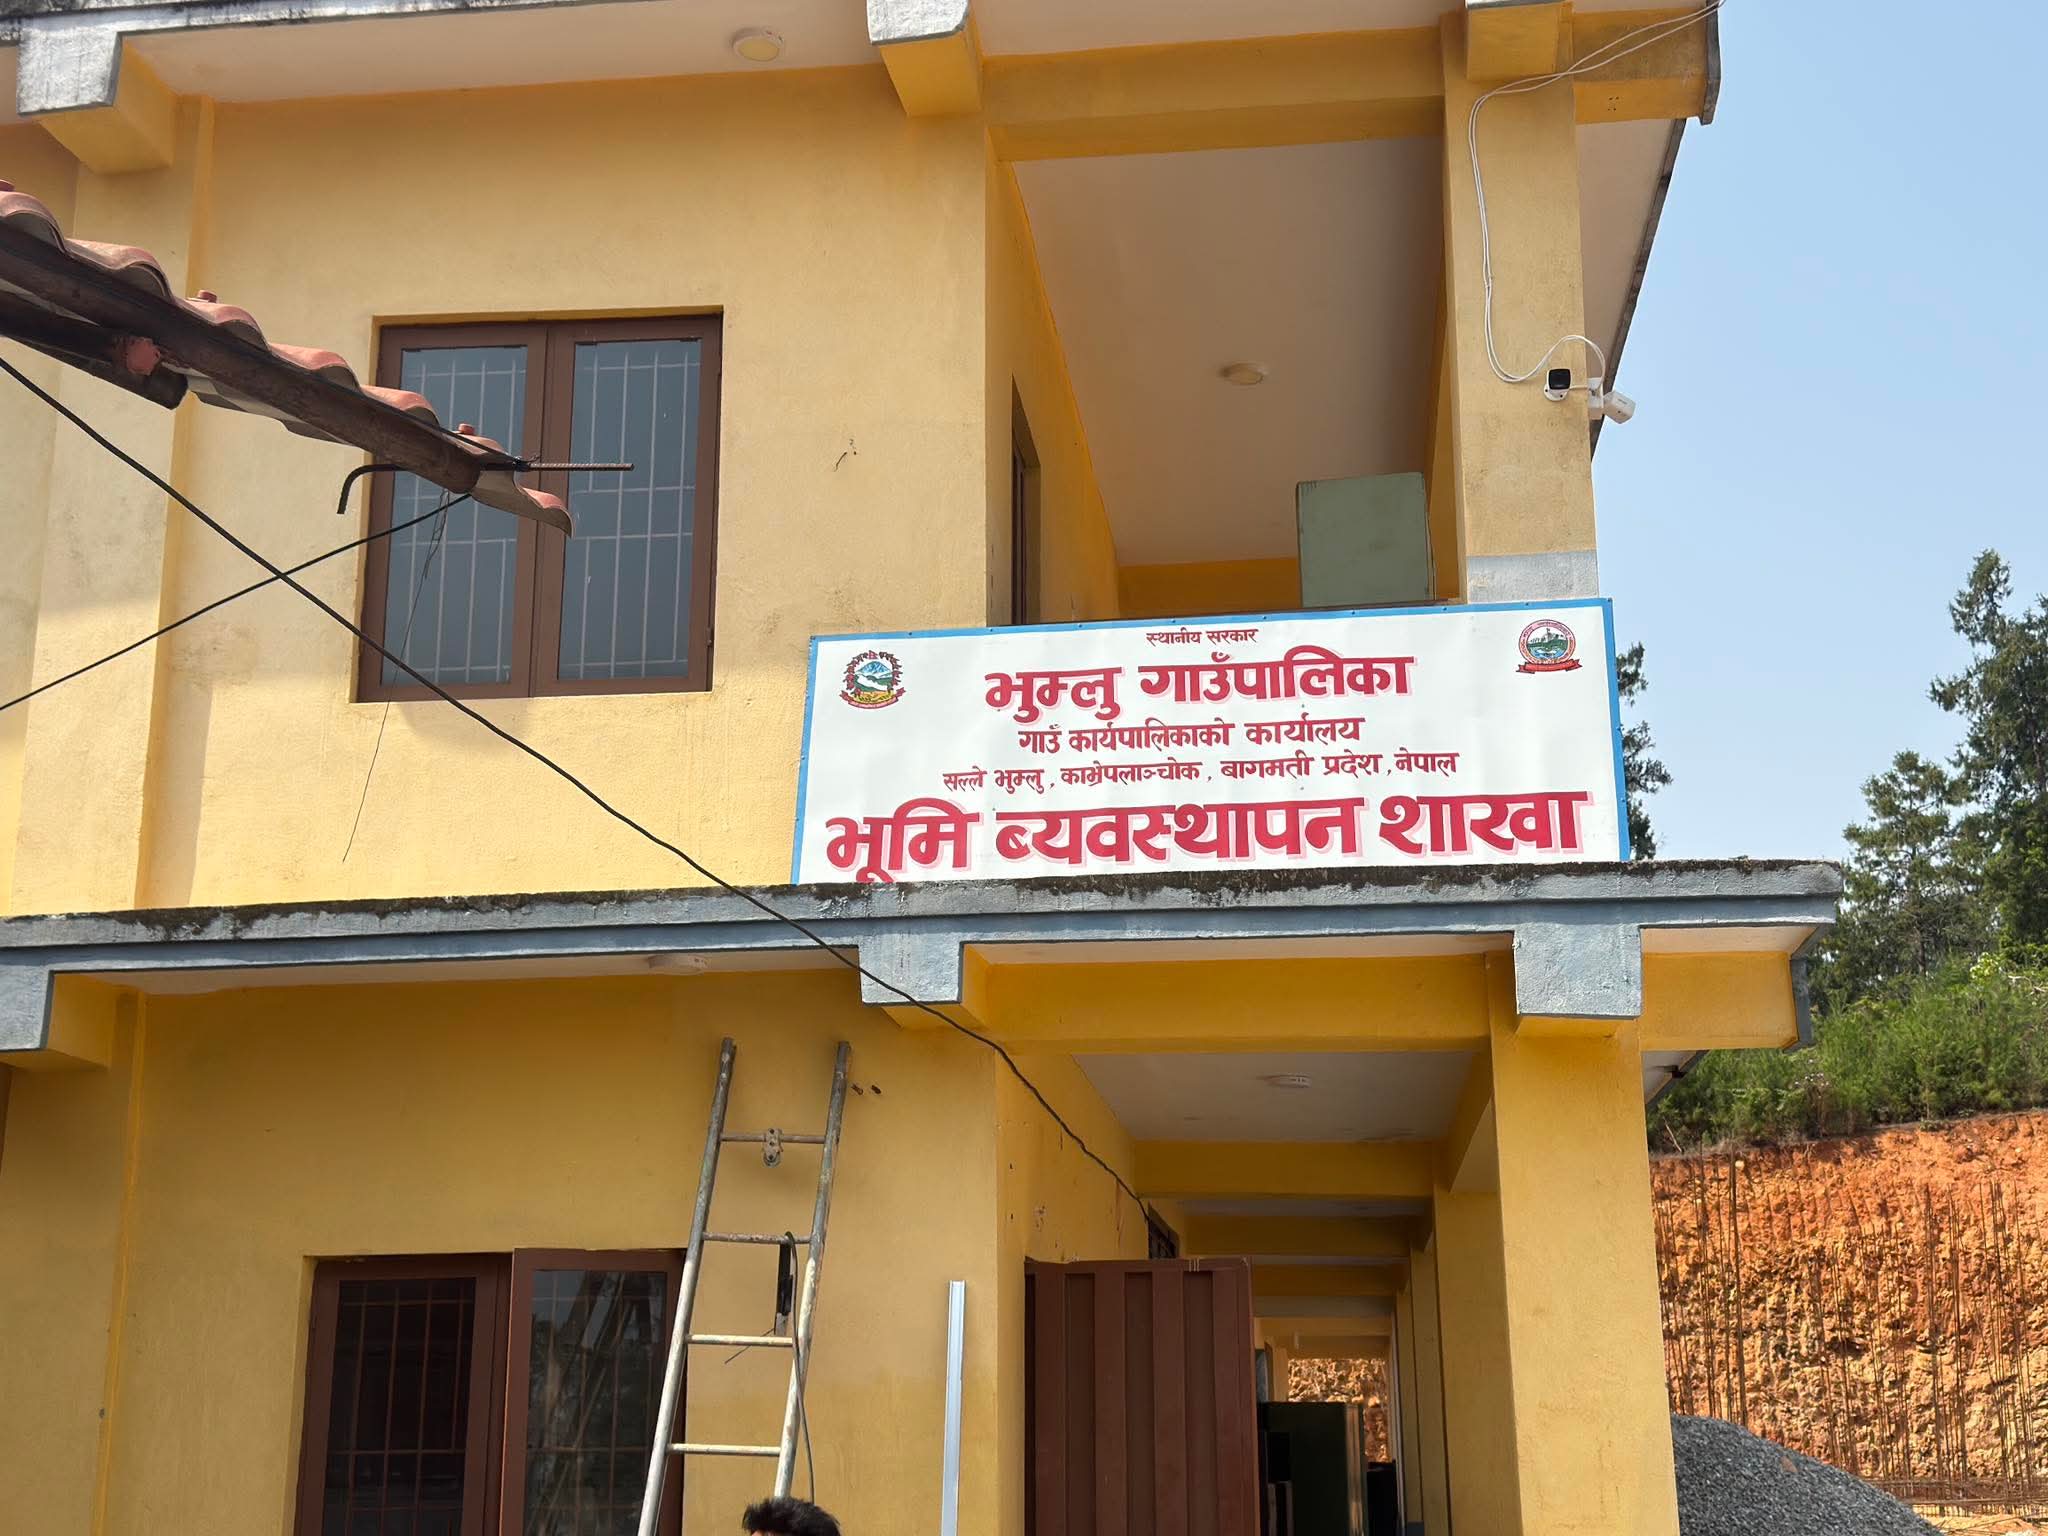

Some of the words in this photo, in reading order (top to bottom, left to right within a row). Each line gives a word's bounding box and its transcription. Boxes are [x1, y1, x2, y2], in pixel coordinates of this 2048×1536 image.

[1145, 627, 1202, 646] स्थानीय
[1206, 628, 1259, 643] सरकार
[984, 667, 1122, 722] भुम्लु
[1138, 645, 1415, 703] गाउँपालिका
[1068, 717, 1235, 754] कार्यपालिकाको
[1244, 712, 1366, 746] कार्यालय
[942, 765, 988, 793] सल्ले
[1220, 749, 1315, 779] बागमती
[1393, 747, 1460, 778] नेपाल
[1380, 792, 1589, 855] शाखा
